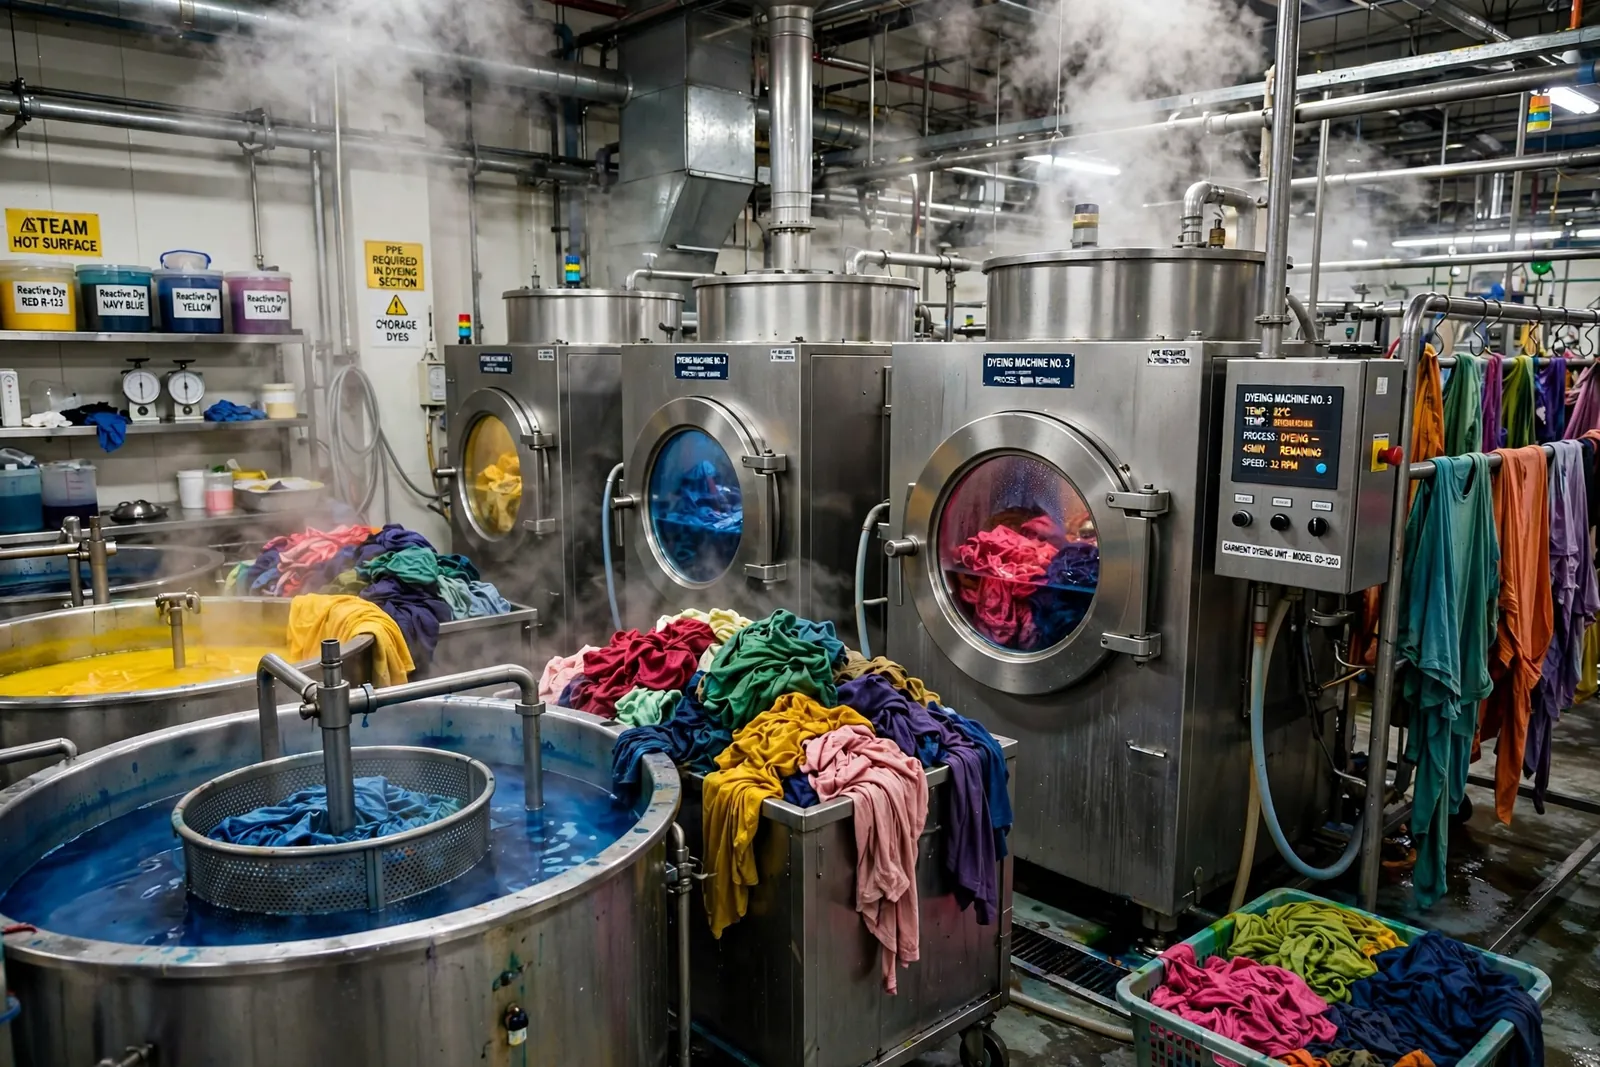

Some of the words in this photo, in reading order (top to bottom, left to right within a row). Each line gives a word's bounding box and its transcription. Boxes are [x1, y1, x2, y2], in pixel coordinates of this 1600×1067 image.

[13, 236, 39, 248] HOT
[43, 237, 97, 252] SURFACE
[386, 245, 403, 255] PPE
[372, 255, 418, 266] REQUIRED
[373, 266, 383, 275] IN
[385, 267, 417, 277] DYEING
[379, 277, 417, 288] SECTION
[17, 285, 51, 295] Reactive
[52, 287, 66, 298] Dye
[100, 289, 131, 298] Reactive
[133, 290, 145, 300] Dye
[176, 292, 204, 301] Reactive
[206, 293, 217, 302] Dye
[22, 297, 39, 307] RED
[41, 298, 63, 308] R-123
[103, 300, 124, 309] NAVY
[126, 301, 144, 310] BLUE
[247, 295, 274, 303] Reactive
[276, 295, 287, 304] Dye
[182, 303, 212, 312] YELLOW
[254, 305, 282, 313] YELLOW
[386, 332, 409, 342] DYES
[987, 357, 1013, 367] DYEING
[1014, 357, 1048, 368] MACHINE
[1049, 358, 1063, 368] NO.
[1064, 358, 1070, 368] 3
[1244, 393, 1273, 403] DYEING
[1274, 393, 1309, 404] MACHINE
[1310, 395, 1325, 405] NO.
[1327, 395, 1333, 405] 3
[1245, 406, 1269, 416] TEMP:
[1243, 431, 1278, 441] PROCESS:
[1280, 433, 1309, 443] DYEING
[1280, 445, 1322, 457] REMAINING
[1242, 458, 1268, 468] SPEED:
[1281, 460, 1298, 470] RPM
[1224, 543, 1251, 554] GARMENT
[1252, 546, 1273, 557] DYEING
[1274, 550, 1287, 559] UNIT
[1292, 552, 1312, 563] MODEL
